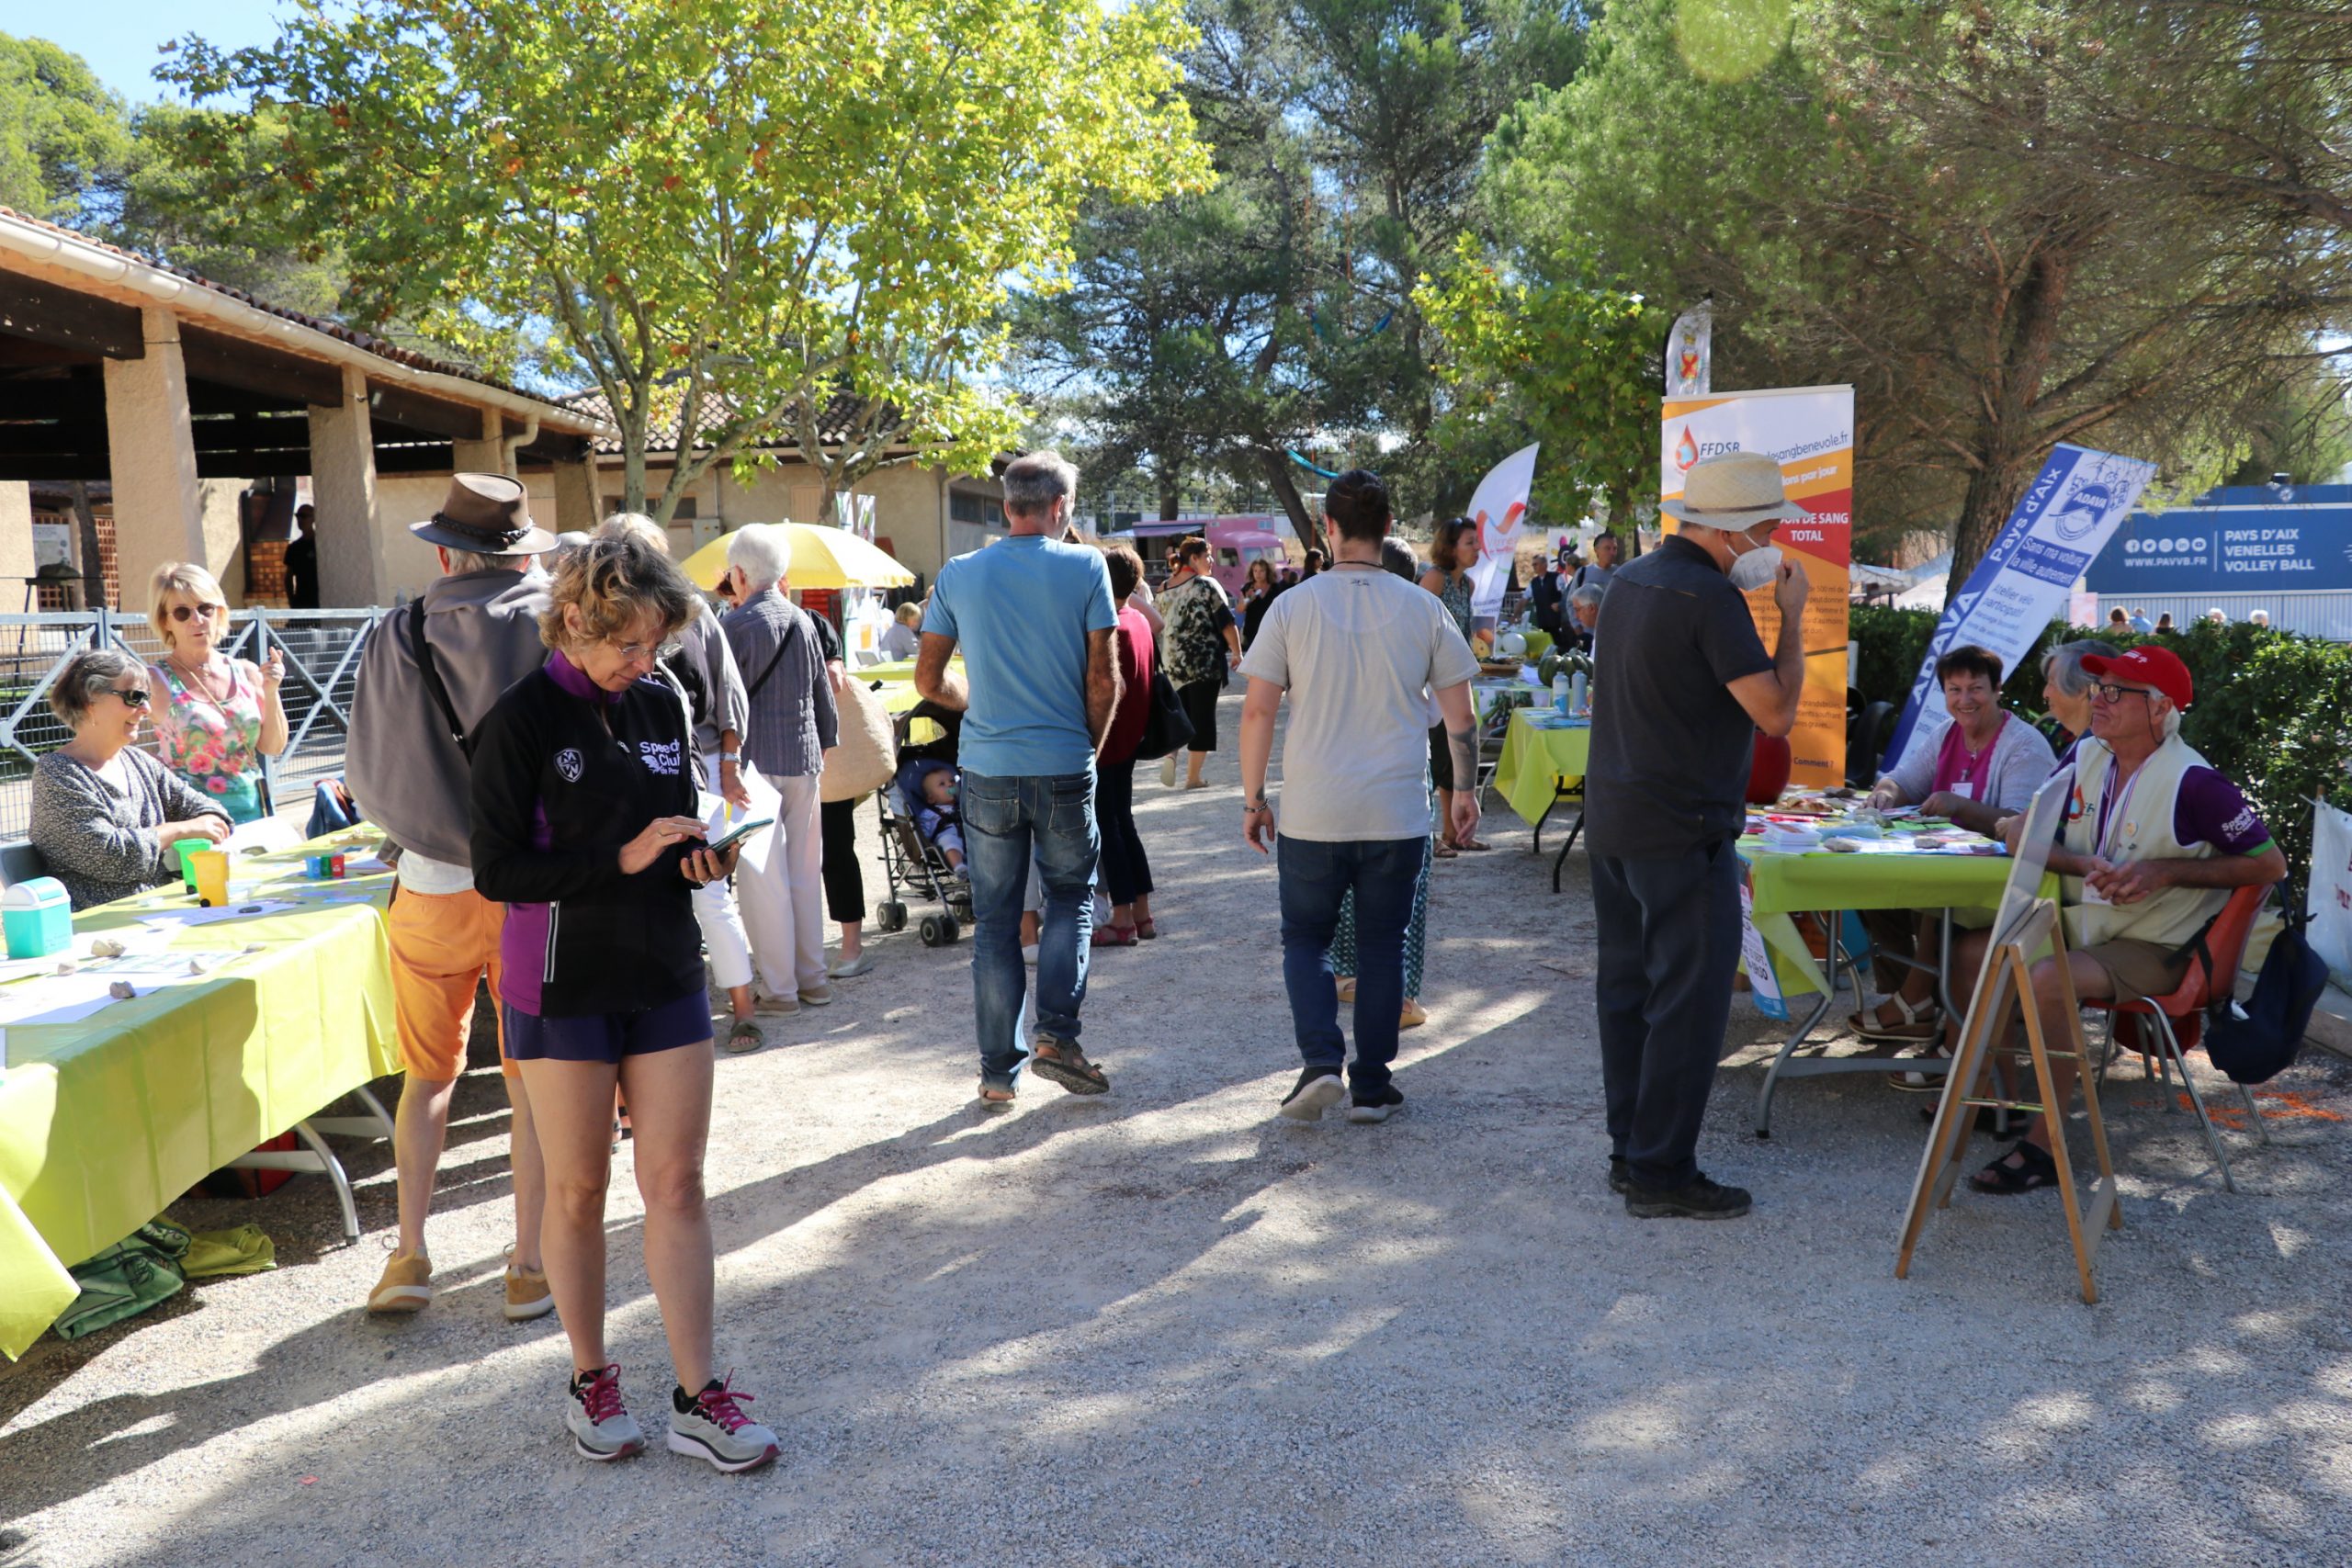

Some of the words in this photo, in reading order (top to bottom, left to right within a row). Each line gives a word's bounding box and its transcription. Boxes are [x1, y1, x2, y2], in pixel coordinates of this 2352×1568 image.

[2073, 491, 2108, 510] ADAVA
[1818, 513, 1849, 524] SANG
[1989, 525, 2029, 562] Pays
[2027, 468, 2062, 513] d'Aix
[1791, 530, 1824, 541] TOTAL
[2224, 529, 2258, 542] PAYS
[2261, 528, 2300, 541] D'AIX
[2022, 537, 2045, 555] Sans
[2043, 547, 2060, 559] ma
[2224, 544, 2296, 557] VENELLES
[2124, 557, 2208, 568] WWW.PAVVB.FR
[2224, 559, 2278, 572] VOLLEY
[2279, 558, 2315, 571] BALL
[2035, 566, 2075, 584] autrement
[1913, 590, 1982, 706] ADAVA
[639, 738, 680, 755] Speed
